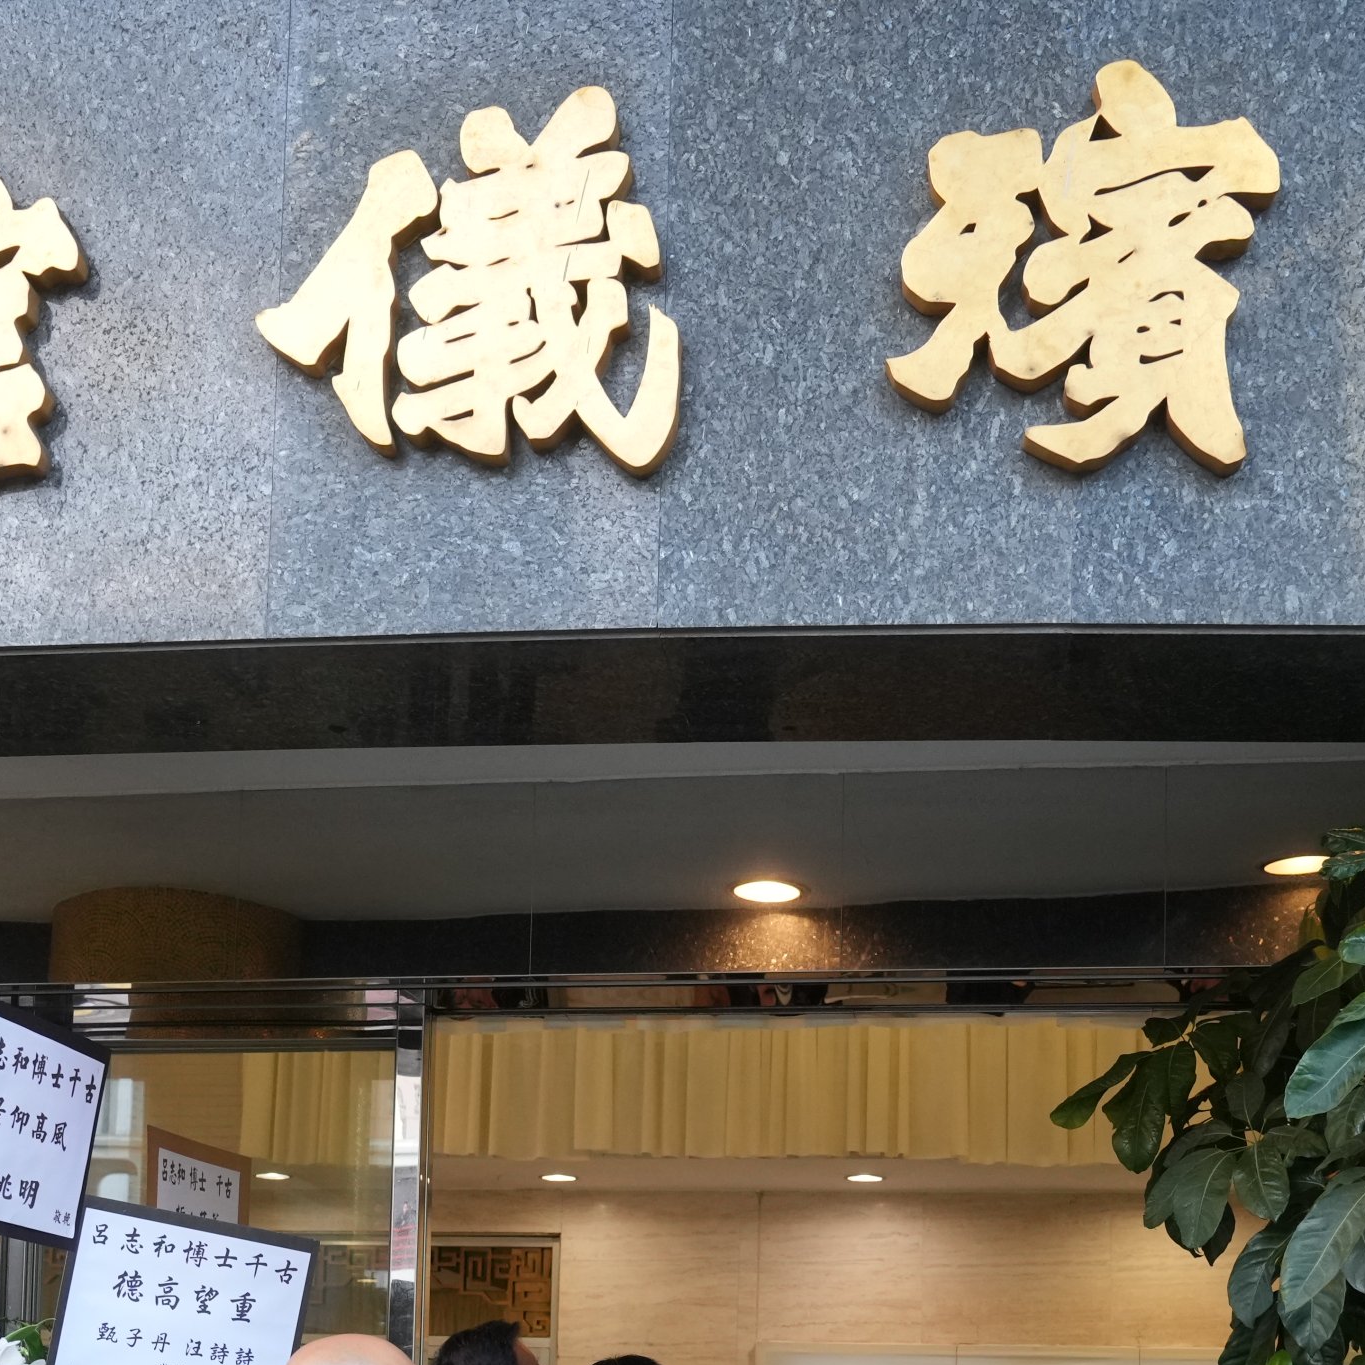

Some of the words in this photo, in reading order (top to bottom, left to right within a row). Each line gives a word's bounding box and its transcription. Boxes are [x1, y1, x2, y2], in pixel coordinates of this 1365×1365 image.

[92, 1223, 299, 1285] 呂志和博士千古
[112, 1270, 257, 1323] 德高望重
